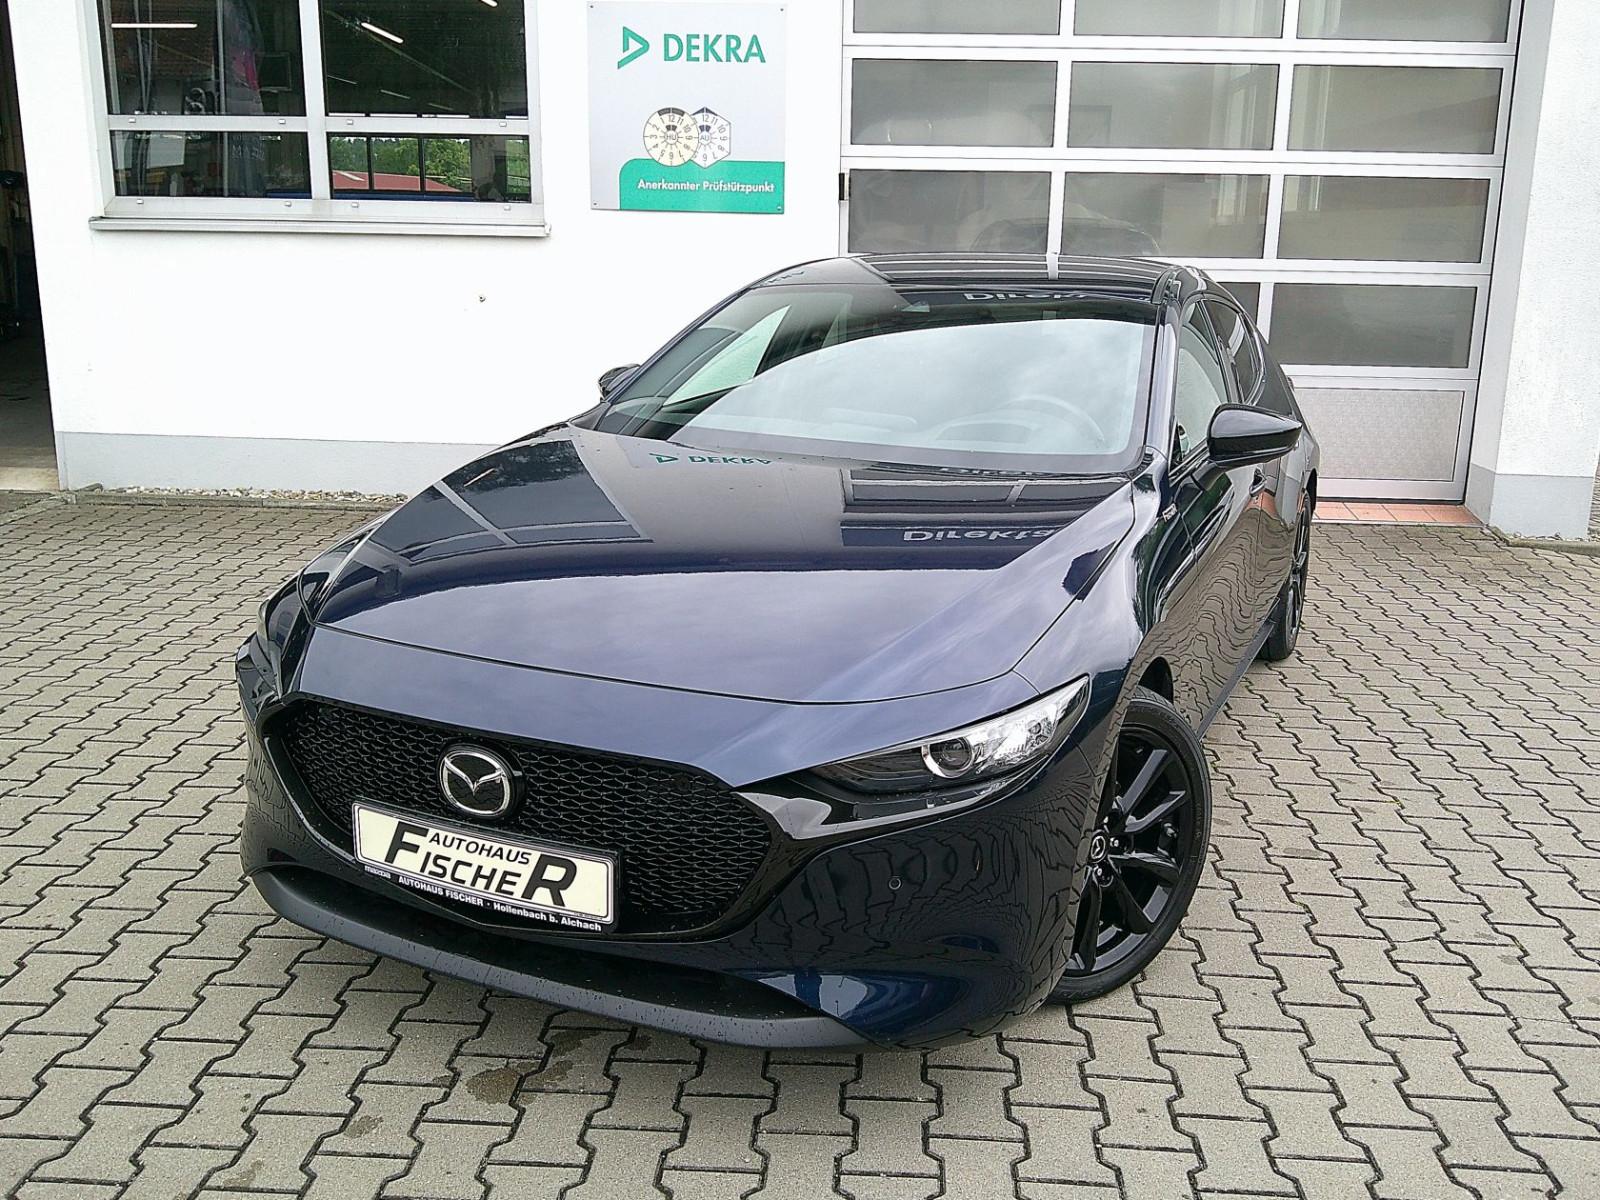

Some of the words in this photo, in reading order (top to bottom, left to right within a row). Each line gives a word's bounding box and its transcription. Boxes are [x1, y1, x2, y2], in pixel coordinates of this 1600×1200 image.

[663, 33, 767, 63] DEKRA
[637, 178, 701, 191] Anerkannter
[702, 180, 775, 194] Prüfstützpunkt
[384, 820, 577, 907] FISCHER
[429, 832, 532, 865] AUTOHAUS
[398, 876, 444, 896] AUTOHAUS
[445, 889, 484, 907] FISCHER
[493, 902, 548, 921] Hollenbach
[548, 912, 559, 924] b.
[560, 916, 602, 932] Aichach
